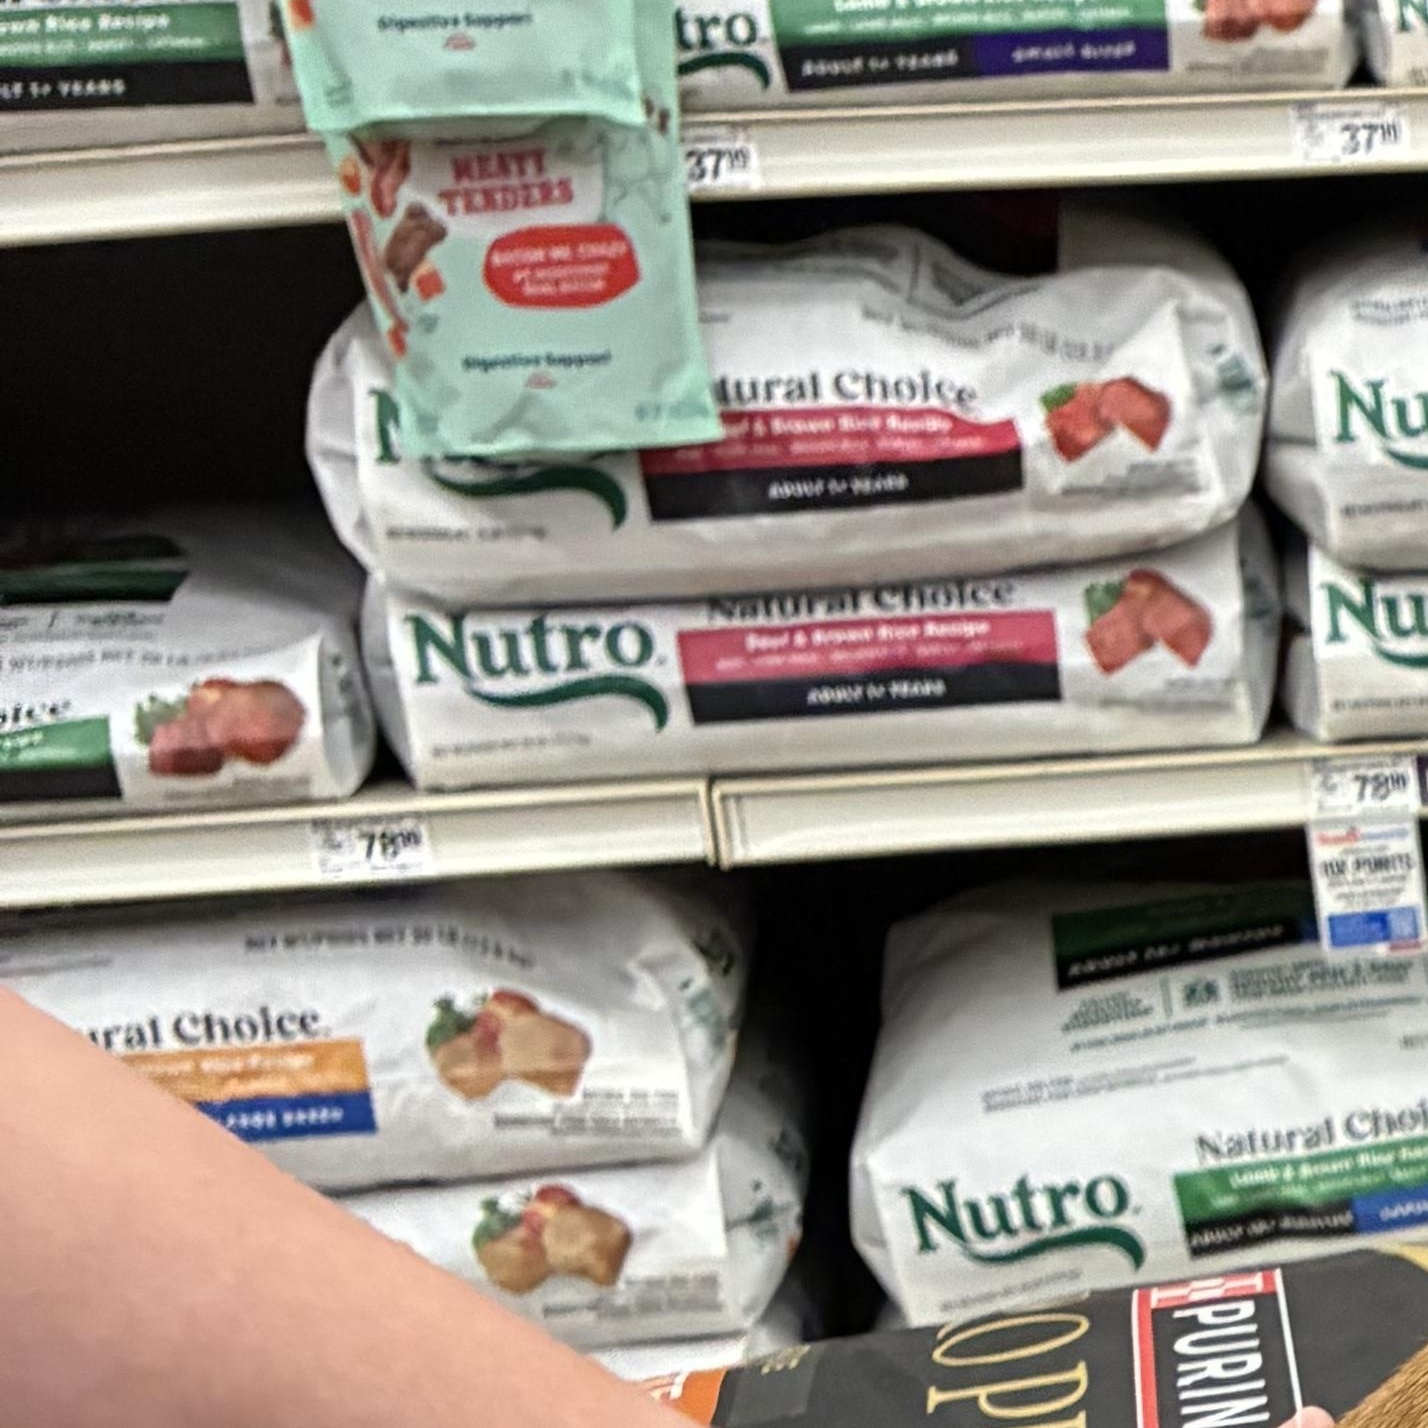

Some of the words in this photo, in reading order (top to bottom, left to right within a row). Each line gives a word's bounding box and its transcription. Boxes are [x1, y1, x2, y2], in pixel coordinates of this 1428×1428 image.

[677, 3, 760, 50] tro
[714, 371, 819, 404] tural
[835, 368, 978, 407] Choice
[406, 611, 654, 683] Nutro
[174, 1004, 322, 1045] Choice
[1194, 1116, 1335, 1166] Natural
[902, 1169, 1129, 1255] Nutro
